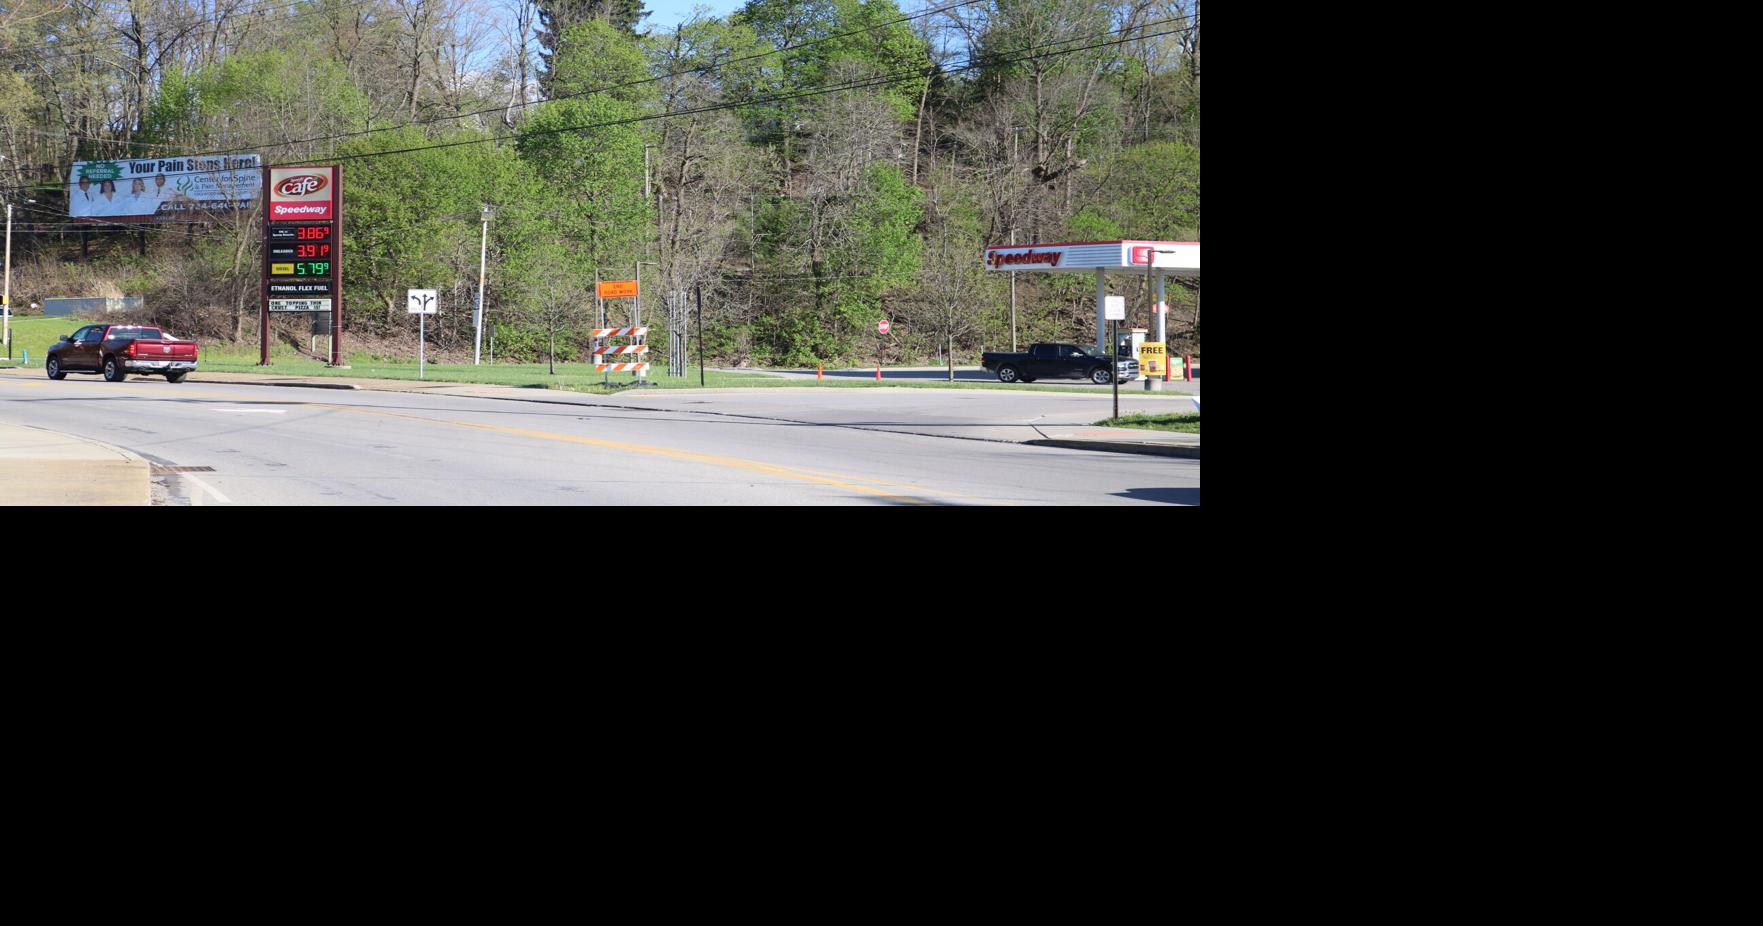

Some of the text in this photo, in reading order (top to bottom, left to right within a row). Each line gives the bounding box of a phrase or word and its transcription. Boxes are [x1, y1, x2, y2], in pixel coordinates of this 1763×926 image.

[129, 161, 155, 174] Your
[158, 159, 184, 172] Pain
[223, 156, 256, 169] Here!
[234, 174, 256, 184] Spine
[161, 203, 186, 211] CALL
[274, 205, 327, 215] Speedway
[987, 249, 1061, 268] Speedway
[1141, 346, 1164, 354] FREE
